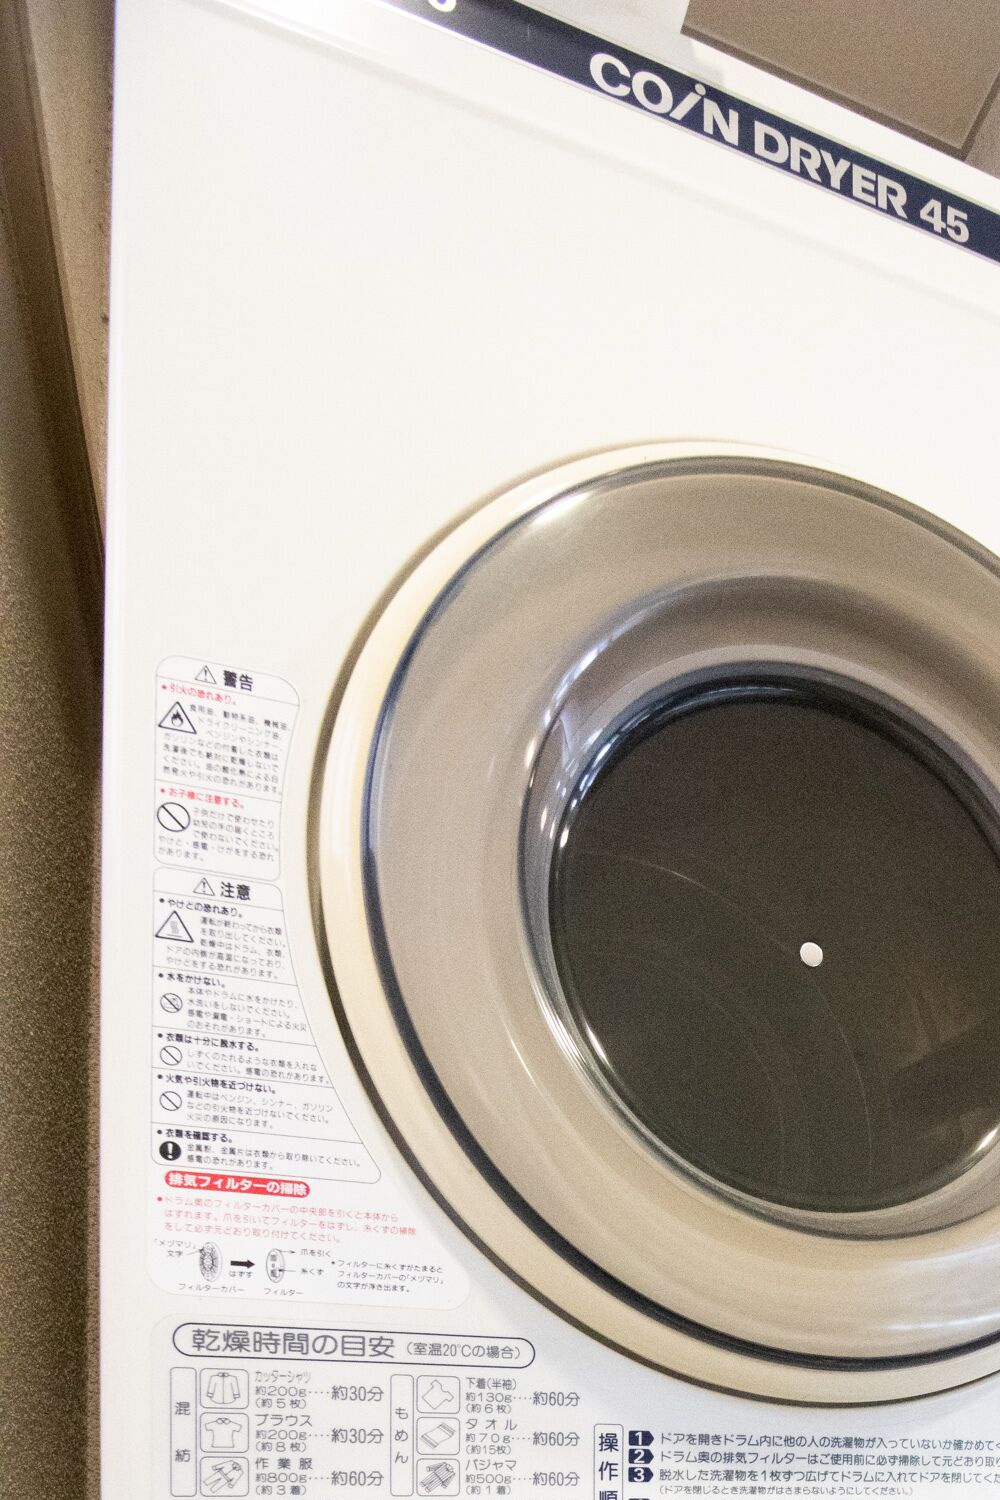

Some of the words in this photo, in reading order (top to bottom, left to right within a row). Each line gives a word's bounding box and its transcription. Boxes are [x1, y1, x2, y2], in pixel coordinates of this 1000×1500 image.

[753, 118, 909, 218] DRYER
[919, 199, 970, 244] 45
[223, 670, 253, 691] 警告
[169, 787, 245, 809] お子様に注意する。
[220, 881, 251, 901] 注意
[168, 898, 242, 918] やけどの恐れあり。
[200, 928, 286, 948] を取り出してください。
[166, 972, 225, 988] 水をかけない。
[166, 1033, 259, 1051] 衣類は十分に脱水する。
[166, 1073, 276, 1094] 火気や引火物を近づけない。
[165, 1128, 232, 1144] 衣類を確認する。
[187, 1154, 273, 1170] 感電の恐れがあります。
[169, 1172, 307, 1197] 排気フィルターの掃除
[165, 1196, 398, 1223] ドラム奥のフィルターカバーの中央部を引くと本体から
[165, 1222, 341, 1243] をして必ず元どおり取り付けてください。
[336, 1260, 444, 1274] フィルターに糸くずがたまると
[178, 1283, 245, 1293] フィルターカバー
[264, 1288, 304, 1296] フィルター
[337, 1280, 411, 1293] の文字が浮き出ます。
[192, 1329, 395, 1358] 乾燥時間の目安
[255, 1370, 312, 1383] カッターシャツ
[255, 1385, 307, 1398] 約200g
[331, 1385, 384, 1403] 約30分
[465, 1391, 512, 1404] 約130g
[533, 1391, 581, 1408] 約60分
[255, 1413, 313, 1427] ブラウス
[255, 1428, 307, 1442] 約200g
[331, 1428, 384, 1445] 約30分
[533, 1431, 581, 1448] 約60分
[465, 1459, 518, 1471] パジャマ
[633, 1450, 645, 1464] 2
[255, 1472, 307, 1484] 約800g
[331, 1470, 384, 1487] 約60分
[465, 1472, 512, 1484] 約500g
[533, 1471, 581, 1487] 約60分
[633, 1468, 645, 1482] 3
